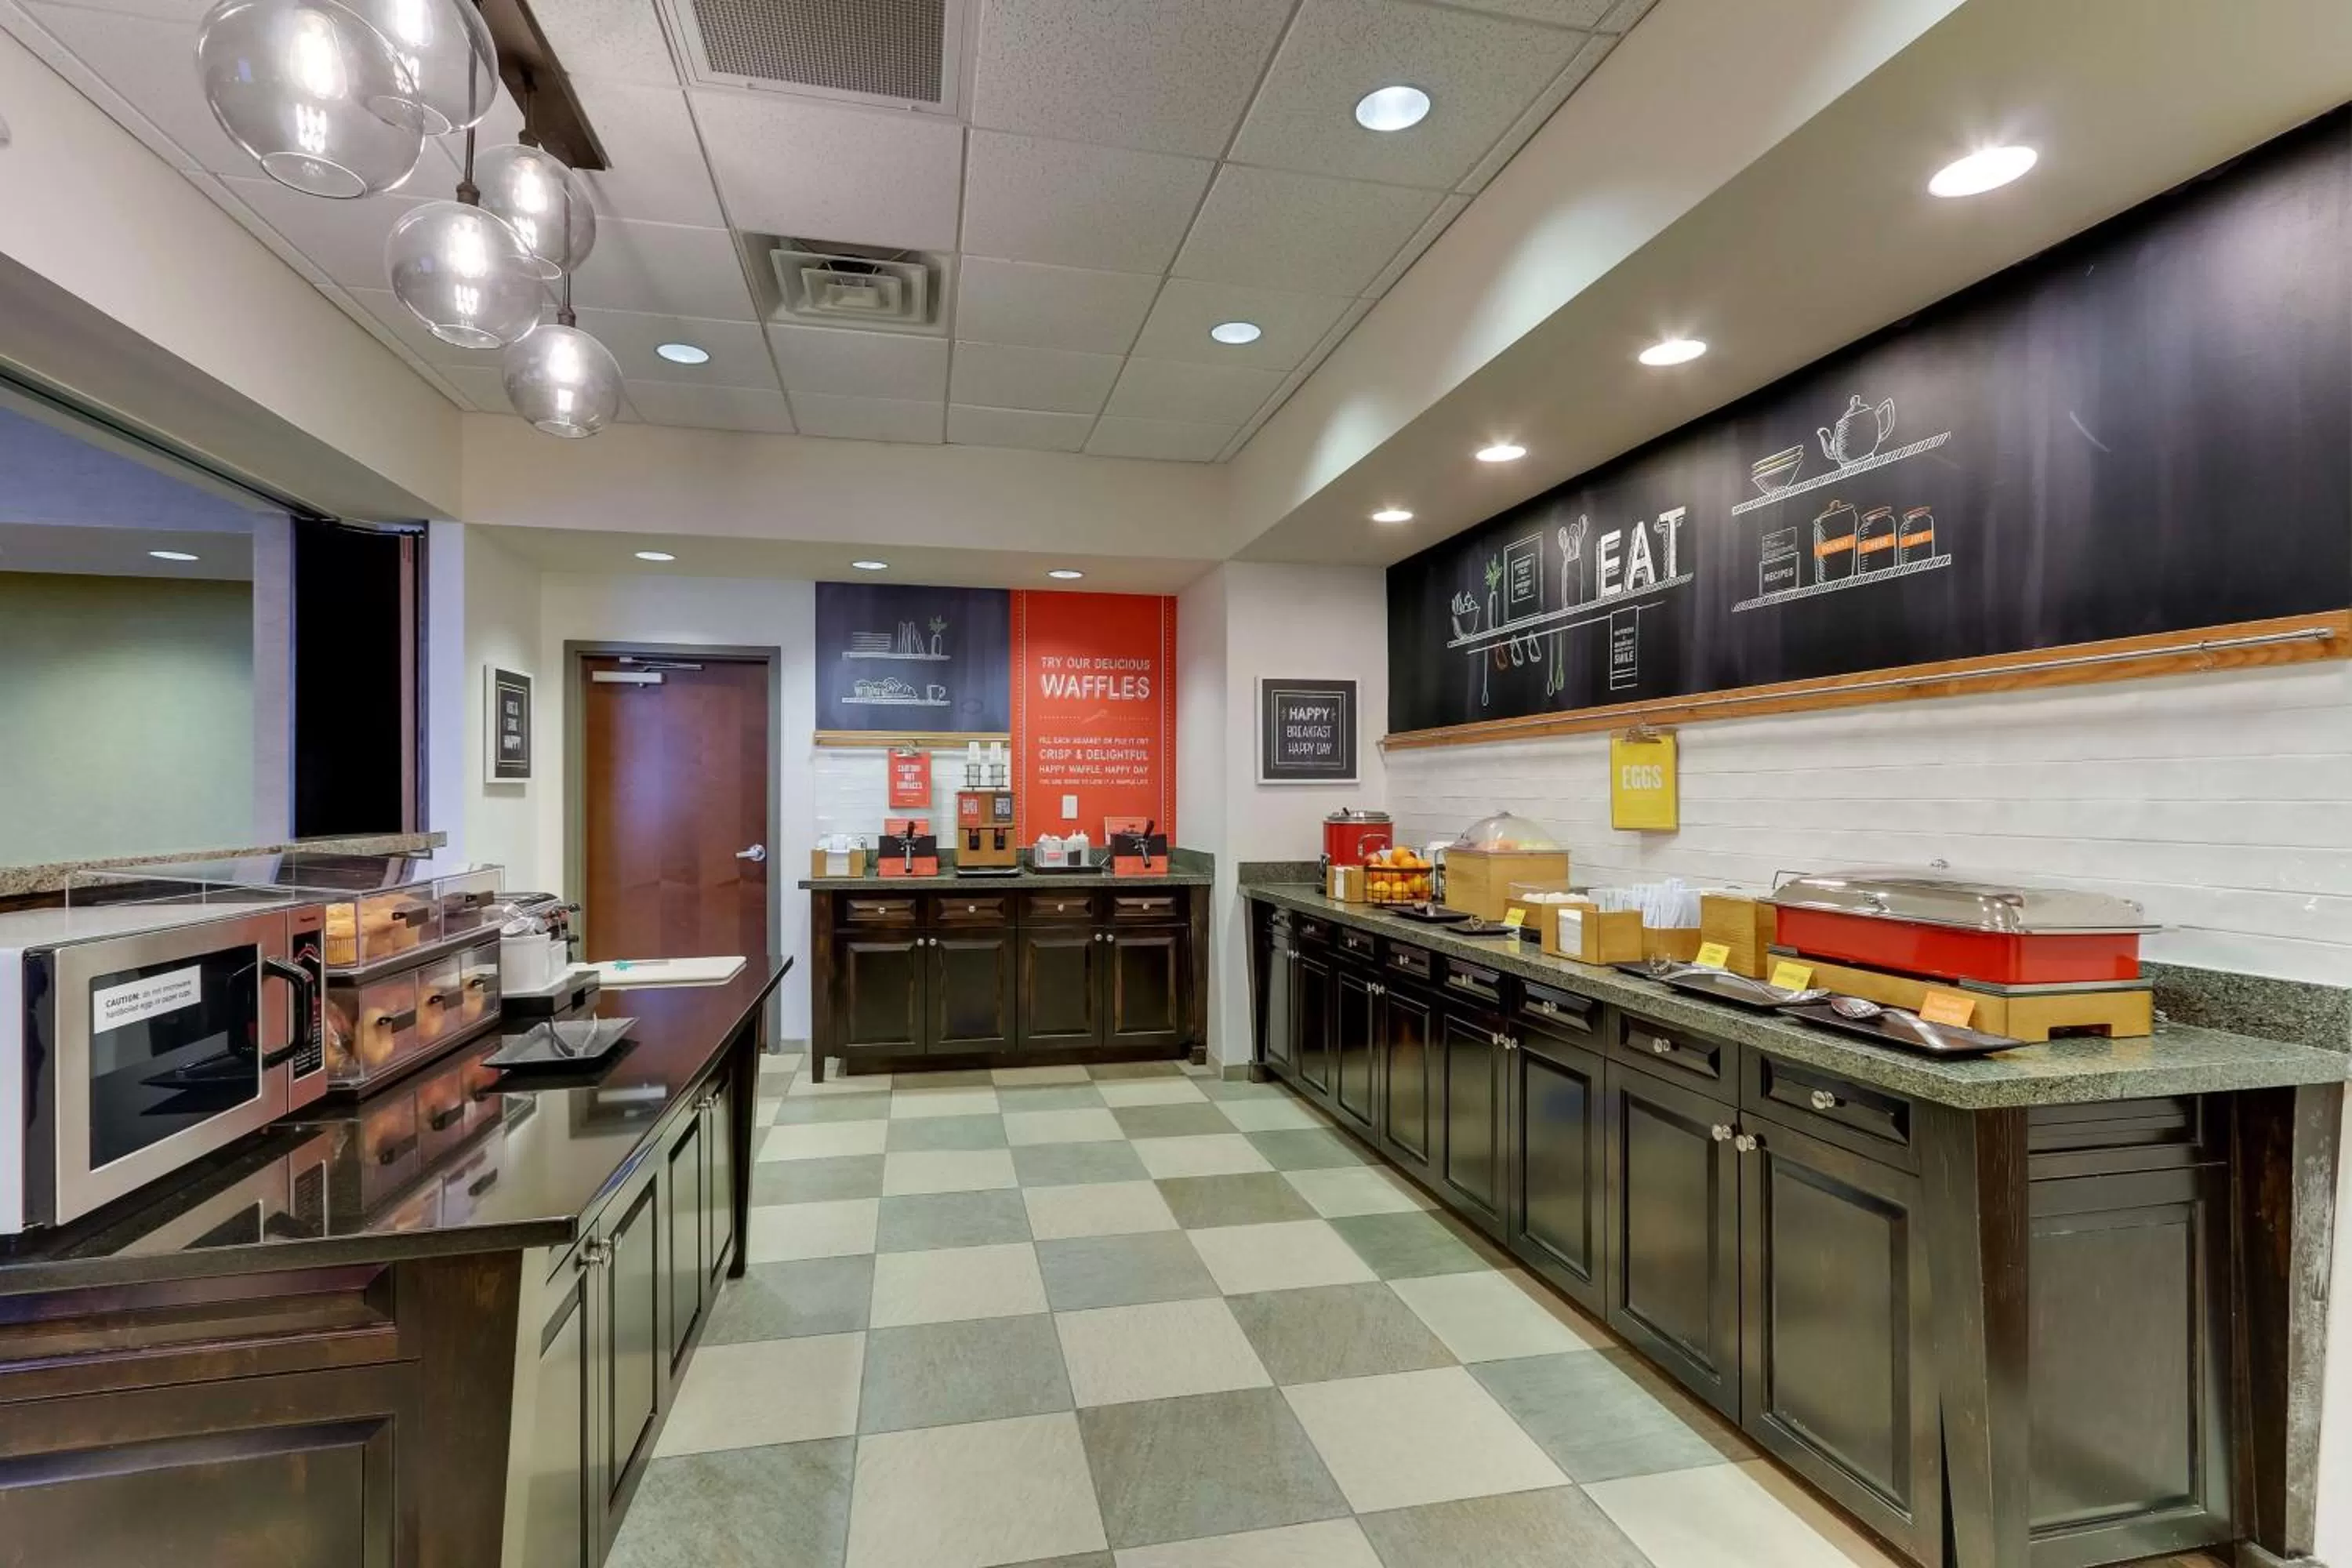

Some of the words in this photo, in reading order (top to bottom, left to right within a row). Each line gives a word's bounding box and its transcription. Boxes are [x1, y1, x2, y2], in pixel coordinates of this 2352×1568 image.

[1596, 506, 1686, 598] EAT
[1764, 567, 1795, 583] RECIPES
[1041, 656, 1063, 669] TRY
[1066, 657, 1091, 669] OUR
[1094, 658, 1151, 670] DELICIOUS
[1040, 673, 1151, 700] WAFFLES
[1288, 706, 1330, 721] HAPPY
[1287, 725, 1332, 738] BREAKFAST
[1039, 749, 1072, 760] CRISP
[1075, 749, 1083, 760] &
[1086, 749, 1149, 760] DELIGHTFUL
[1288, 742, 1315, 755] HAPPY
[1316, 742, 1332, 755] DAY
[1039, 764, 1066, 774] HAPPY
[1105, 764, 1131, 774] HAPPY
[1133, 764, 1149, 774] DAY
[1622, 764, 1662, 791] EGGS
